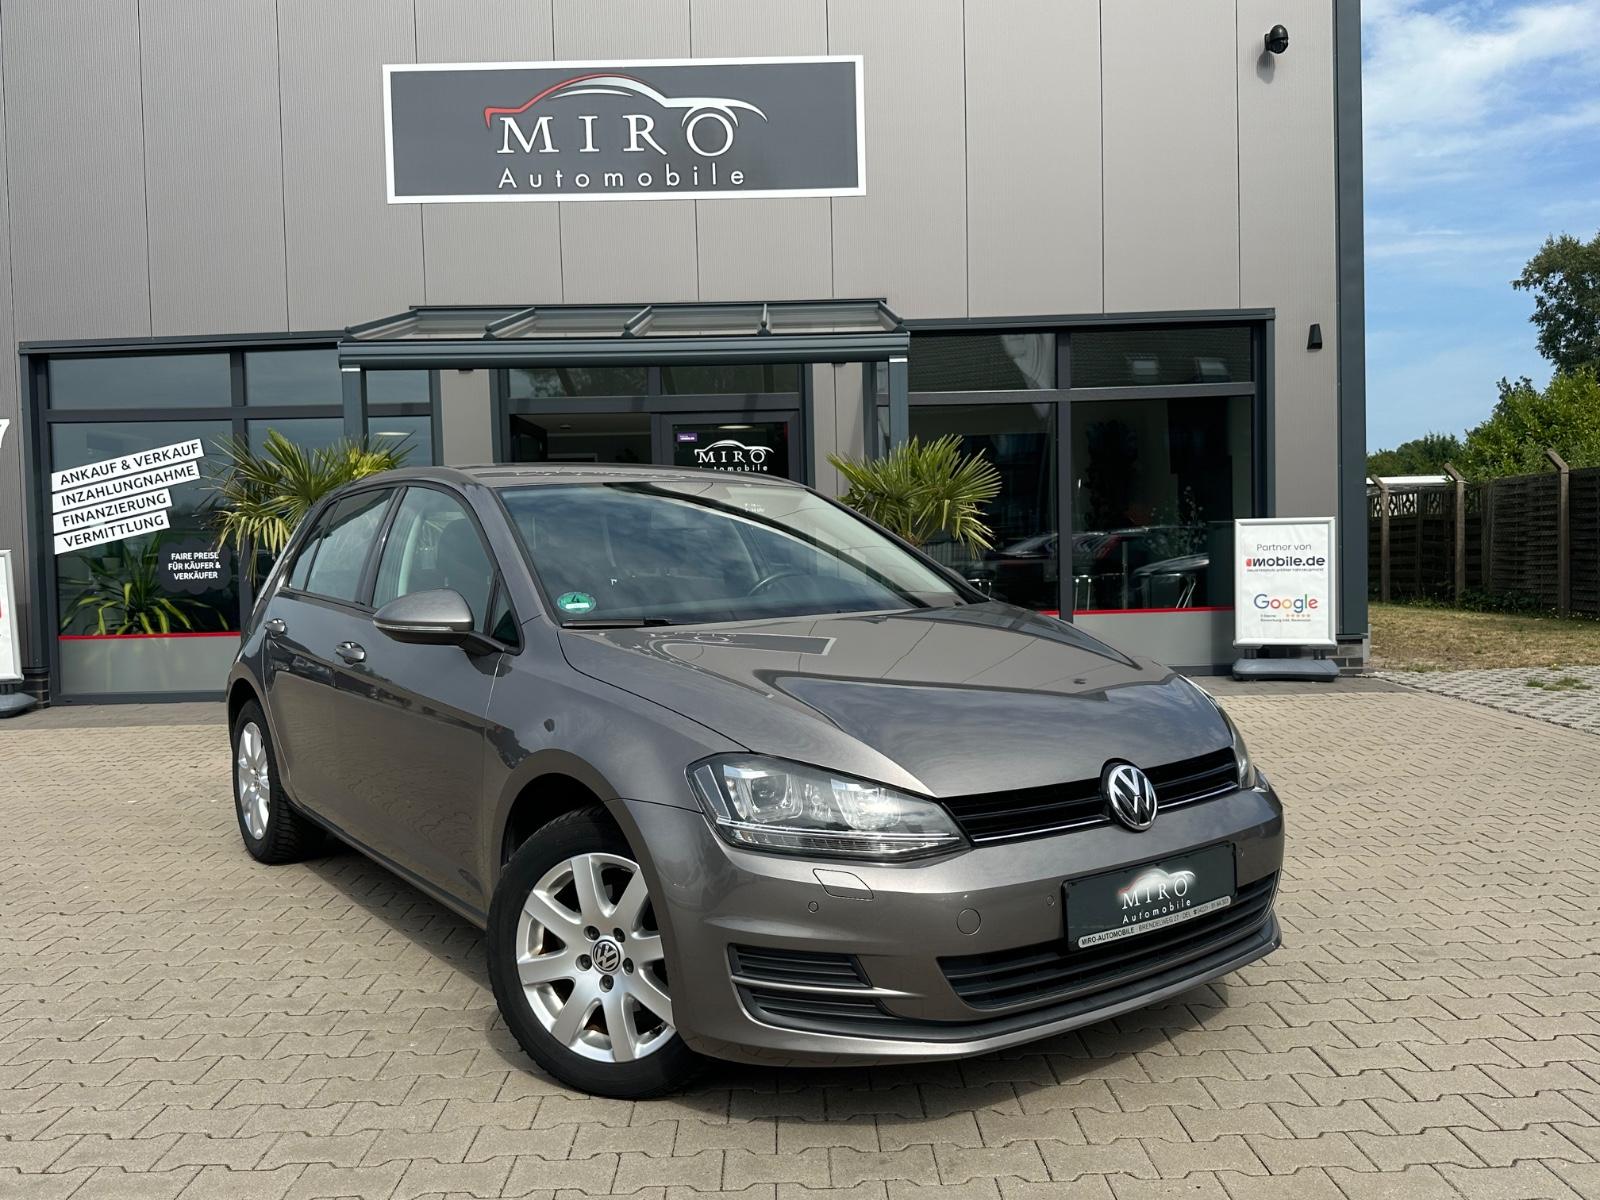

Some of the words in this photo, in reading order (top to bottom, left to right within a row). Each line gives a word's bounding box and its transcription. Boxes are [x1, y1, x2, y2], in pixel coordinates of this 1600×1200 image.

[496, 112, 734, 157] MIRO
[498, 162, 745, 189] Automobile
[60, 462, 117, 485] ANKAUF
[121, 460, 131, 471] &
[133, 443, 199, 467] VERKAUF
[697, 450, 765, 463] MIRO
[61, 465, 196, 506] INZAHLUNGNAHME
[62, 493, 167, 527] FINANZIERUNG
[63, 515, 164, 547] VERMITTLUNG
[171, 552, 192, 560] FAIRE
[1256, 543, 1291, 551] Partner
[168, 561, 183, 570] FÜR
[184, 560, 214, 570] KÄUFER
[215, 561, 221, 569] &
[1252, 556, 1325, 567] mobile.de
[173, 570, 218, 580] VERKÄUFER
[1253, 593, 1319, 613] Google
[1121, 878, 1188, 910] MIRO
[1122, 899, 1191, 924] Automobile
